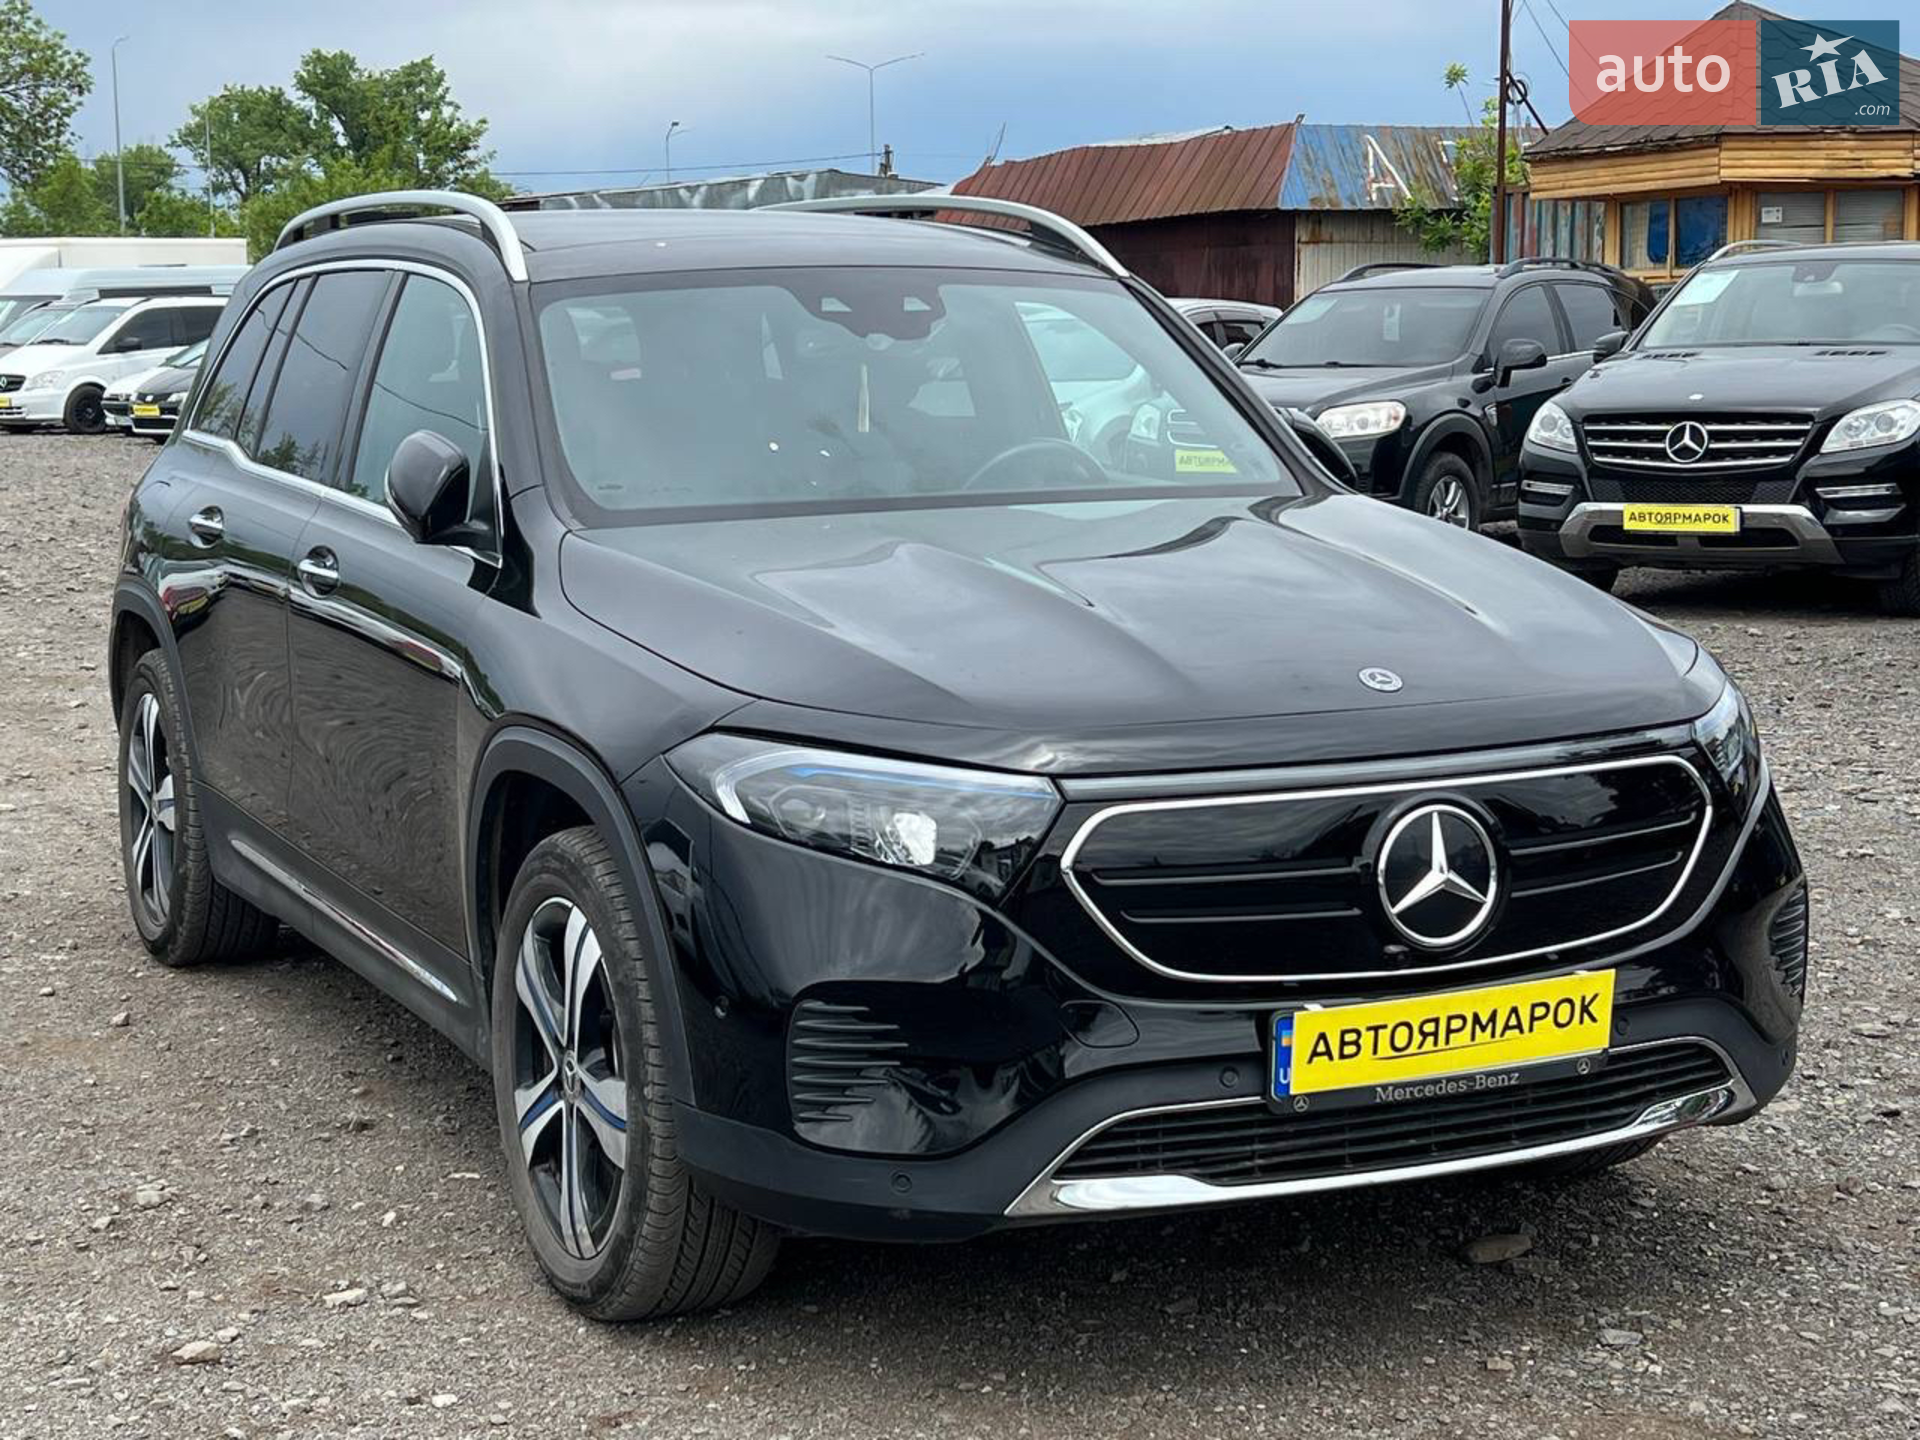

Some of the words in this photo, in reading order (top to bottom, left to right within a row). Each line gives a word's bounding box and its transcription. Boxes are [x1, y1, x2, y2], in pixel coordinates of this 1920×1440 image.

[1628, 511, 1730, 524] АВТОЯРМАРОК
[1306, 992, 1600, 1065] АВТОЯРМАРОК
[1375, 1071, 1520, 1103] Mercedes-Benz
